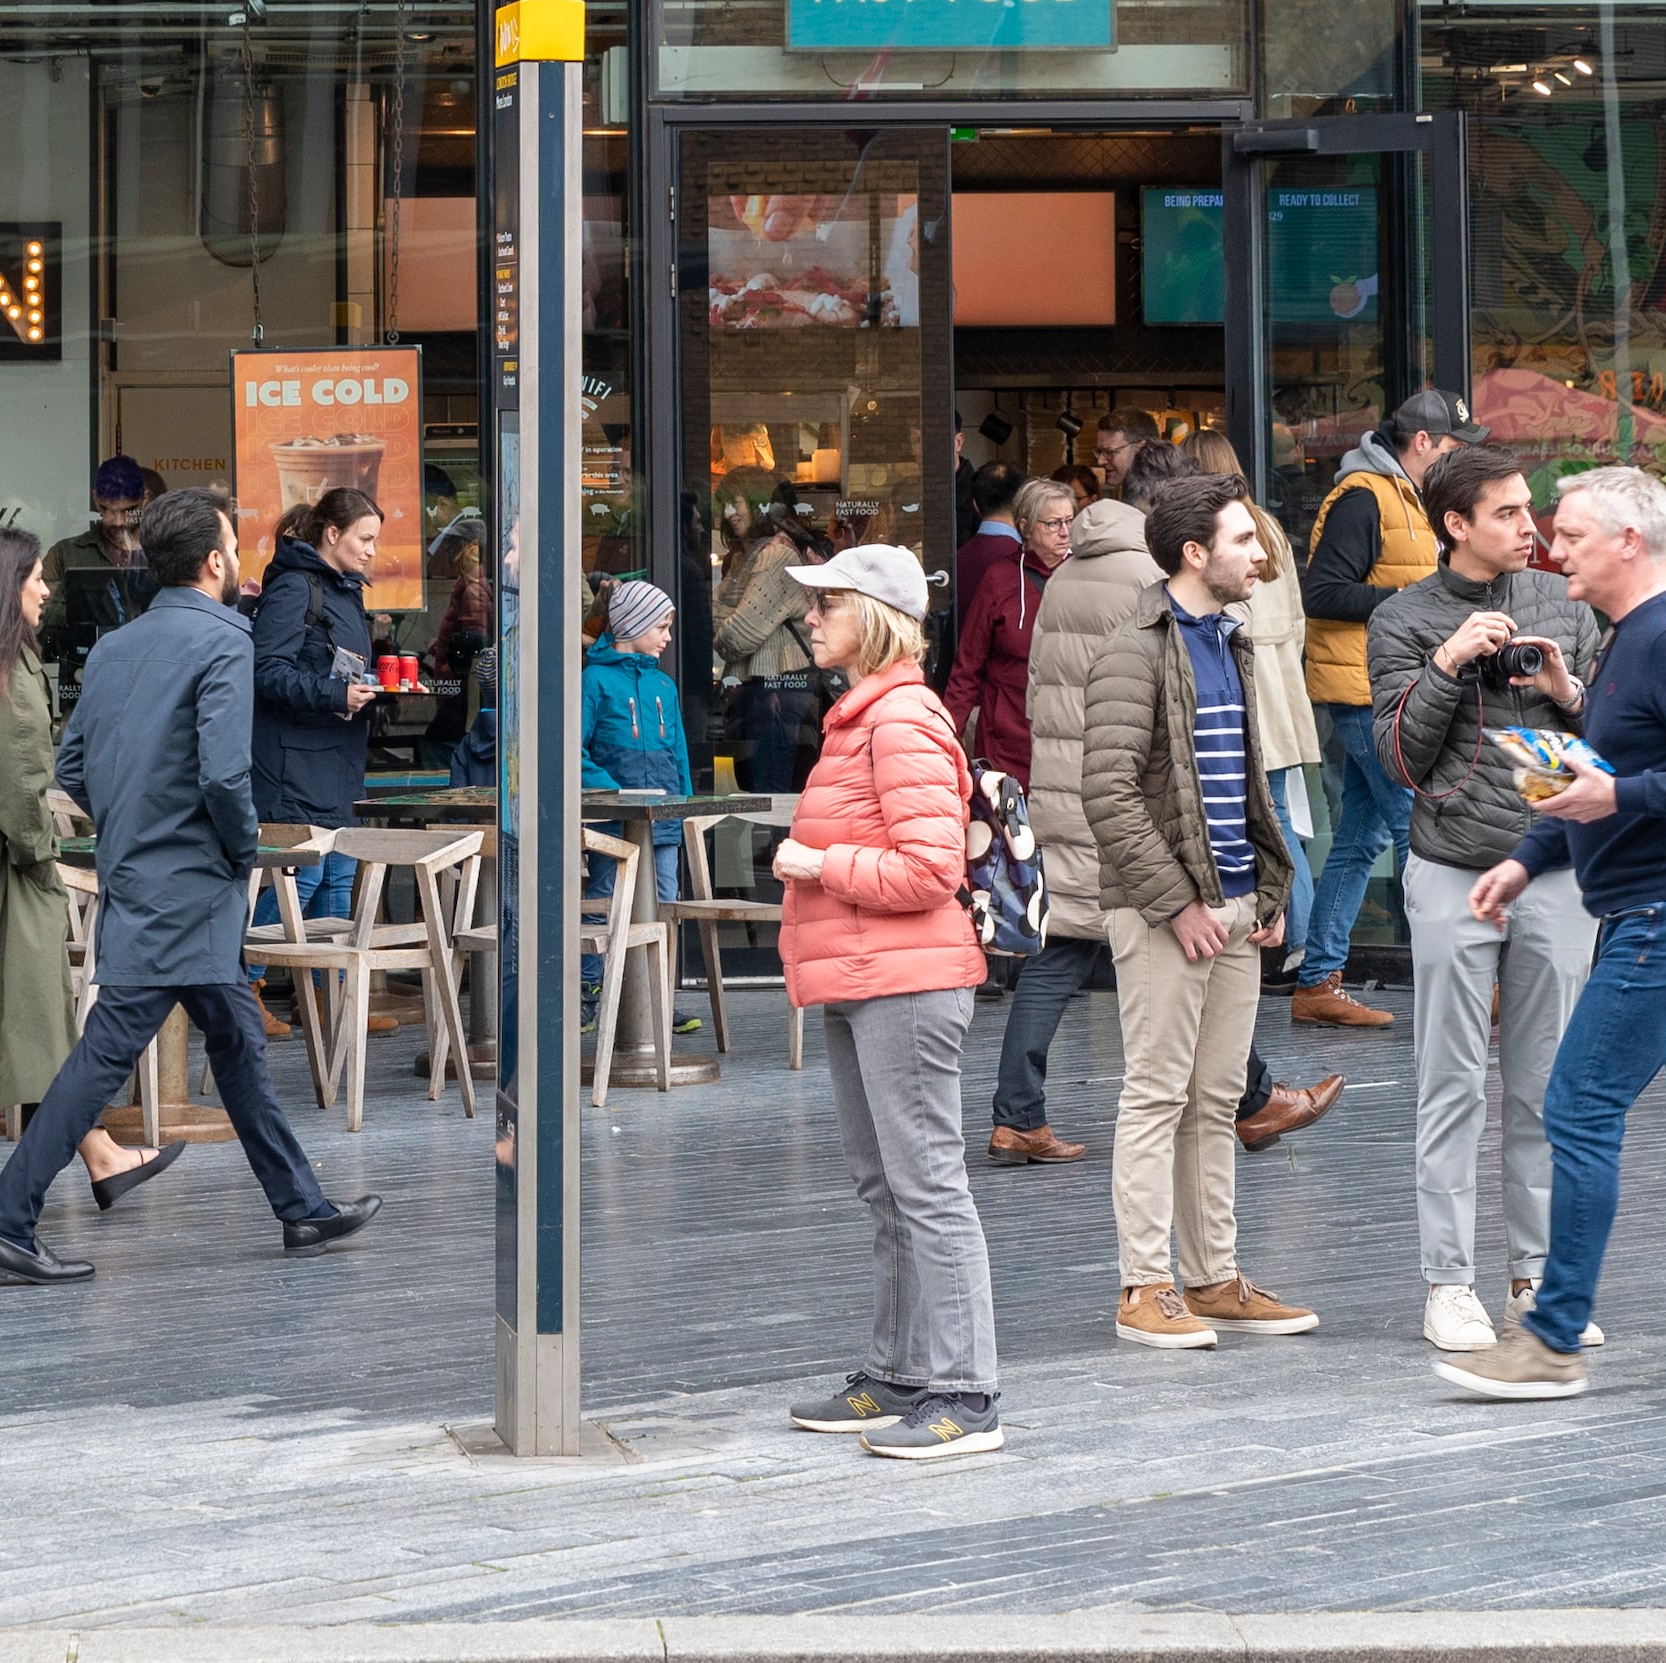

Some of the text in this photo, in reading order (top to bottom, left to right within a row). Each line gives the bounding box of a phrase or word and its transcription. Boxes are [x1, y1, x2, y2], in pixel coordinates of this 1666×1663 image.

[1164, 194, 1224, 208] BEING PREPA
[1279, 194, 1360, 207] READY TO COLLECT
[300, 364, 322, 374] cooler
[323, 363, 341, 373] than
[341, 362, 361, 374] being
[245, 378, 410, 408] ICE COLD
[154, 458, 226, 471] KITCHEN
[835, 508, 854, 516] FAST
[763, 673, 808, 681] NATURALLY
[59, 684, 81, 692] RALLY
[437, 686, 461, 694] FOOD
[763, 681, 808, 689] FAST FOOD
[61, 691, 81, 699] OOD
[927, 1417, 964, 1441] N
